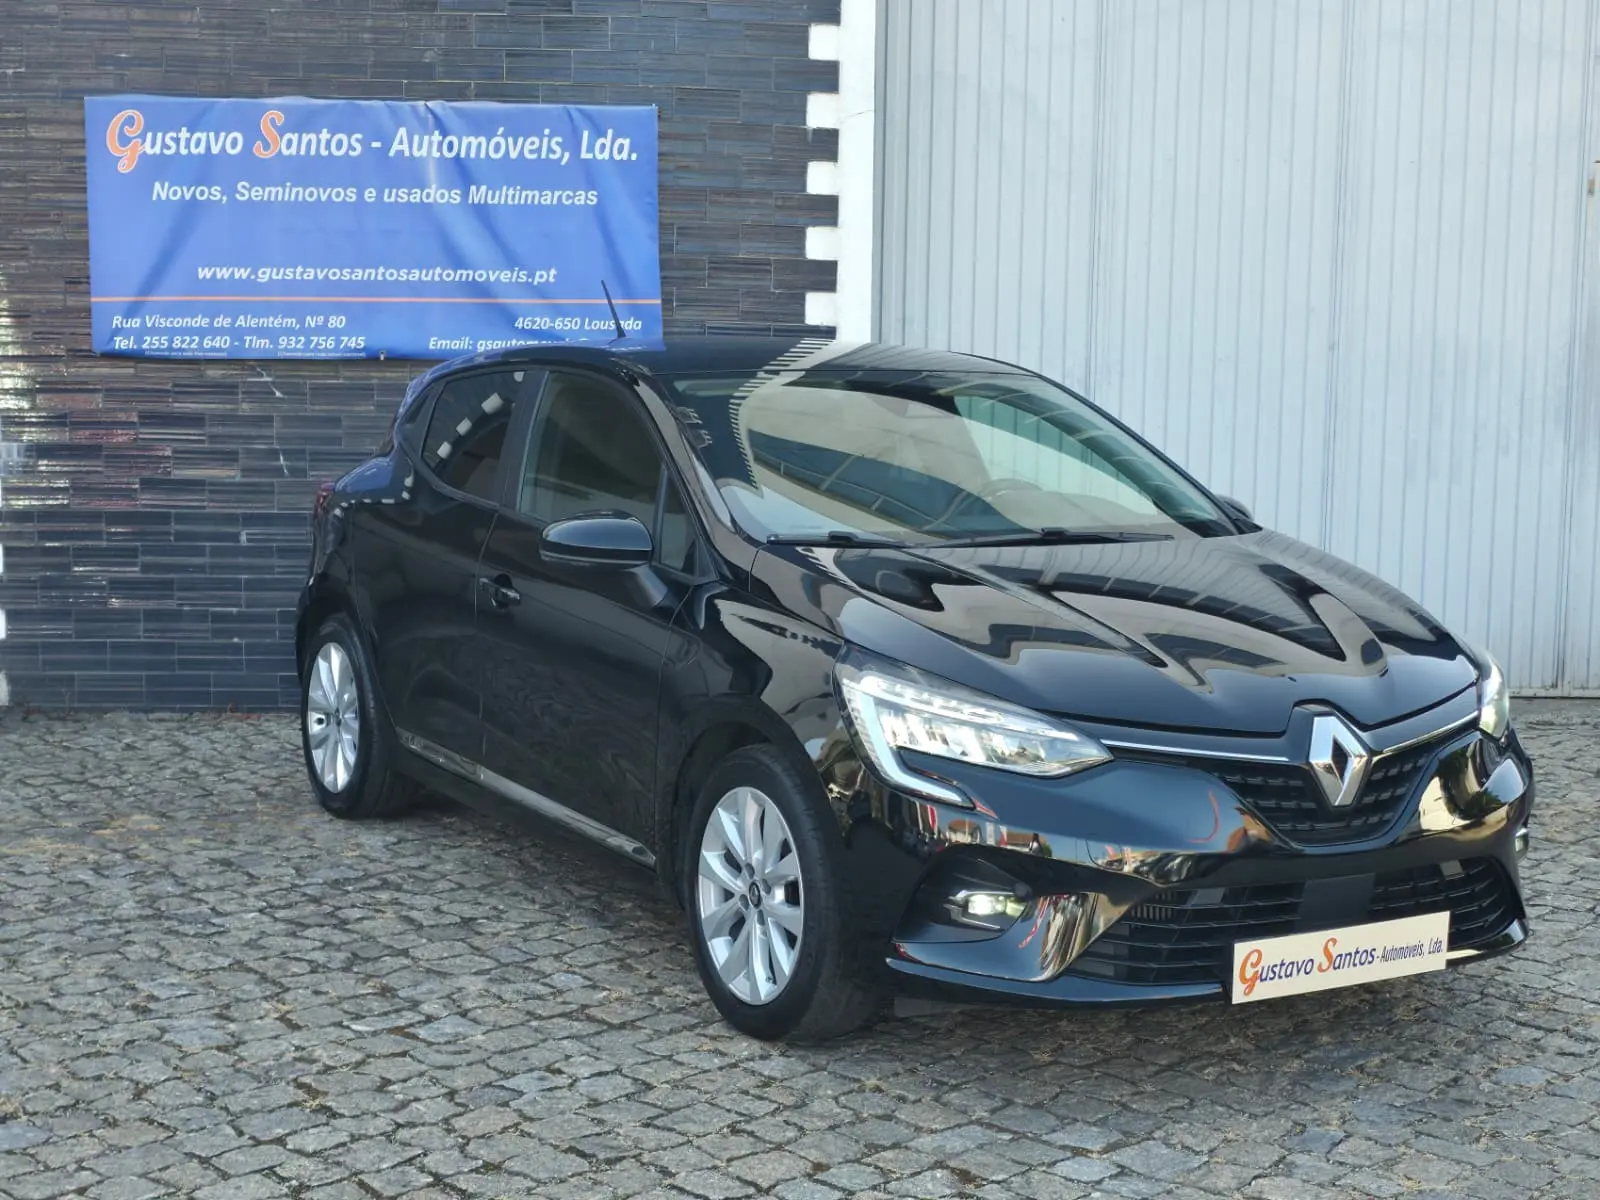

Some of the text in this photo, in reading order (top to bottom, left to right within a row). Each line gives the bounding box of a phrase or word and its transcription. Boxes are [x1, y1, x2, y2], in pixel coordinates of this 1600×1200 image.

[106, 109, 244, 174] Gustavo
[252, 110, 363, 159] Santos
[388, 126, 571, 166] Automóveis,
[579, 128, 639, 162] Lda.
[151, 181, 598, 206] Novos, Seminovos e usados Multimarcas
[197, 265, 558, 286] www.gustavosantosautomoveis.pt
[111, 315, 141, 329] Rua
[145, 314, 210, 328] Visconde
[213, 314, 232, 328] de
[235, 314, 301, 330] Alentém,
[327, 315, 346, 328] 80
[513, 316, 581, 331] 4620-650
[113, 335, 138, 349] Tel.
[142, 335, 169, 349] 255
[172, 335, 200, 349] 822
[203, 335, 231, 349] 640
[244, 335, 274, 349] Tlm.
[277, 335, 306, 349] 932
[309, 336, 336, 350] 756
[340, 336, 366, 350] 745
[428, 336, 473, 350] Email:
[1239, 949, 1314, 996] Gustavo
[1317, 937, 1376, 973] Santos
